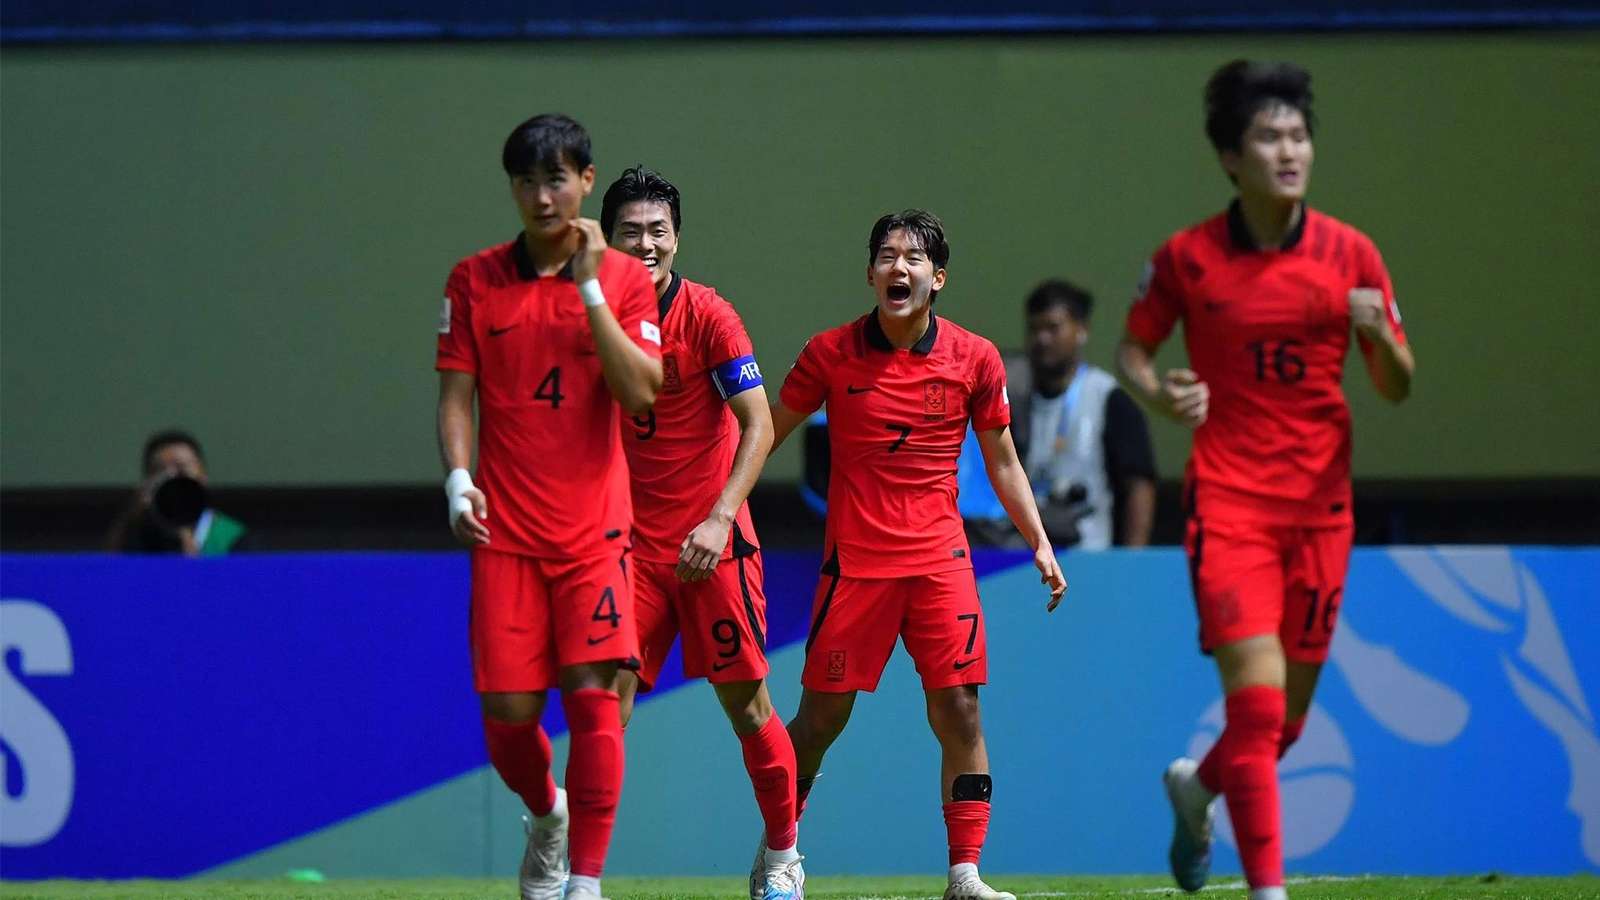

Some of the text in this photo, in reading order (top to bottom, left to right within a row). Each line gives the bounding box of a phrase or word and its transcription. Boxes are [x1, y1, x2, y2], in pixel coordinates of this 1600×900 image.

[1245, 337, 1307, 387] 16
[533, 366, 565, 410] 4
[632, 408, 657, 440] 9
[886, 423, 912, 454] 7
[592, 586, 622, 628] 4
[711, 618, 741, 658] 9
[957, 613, 979, 655] 7
